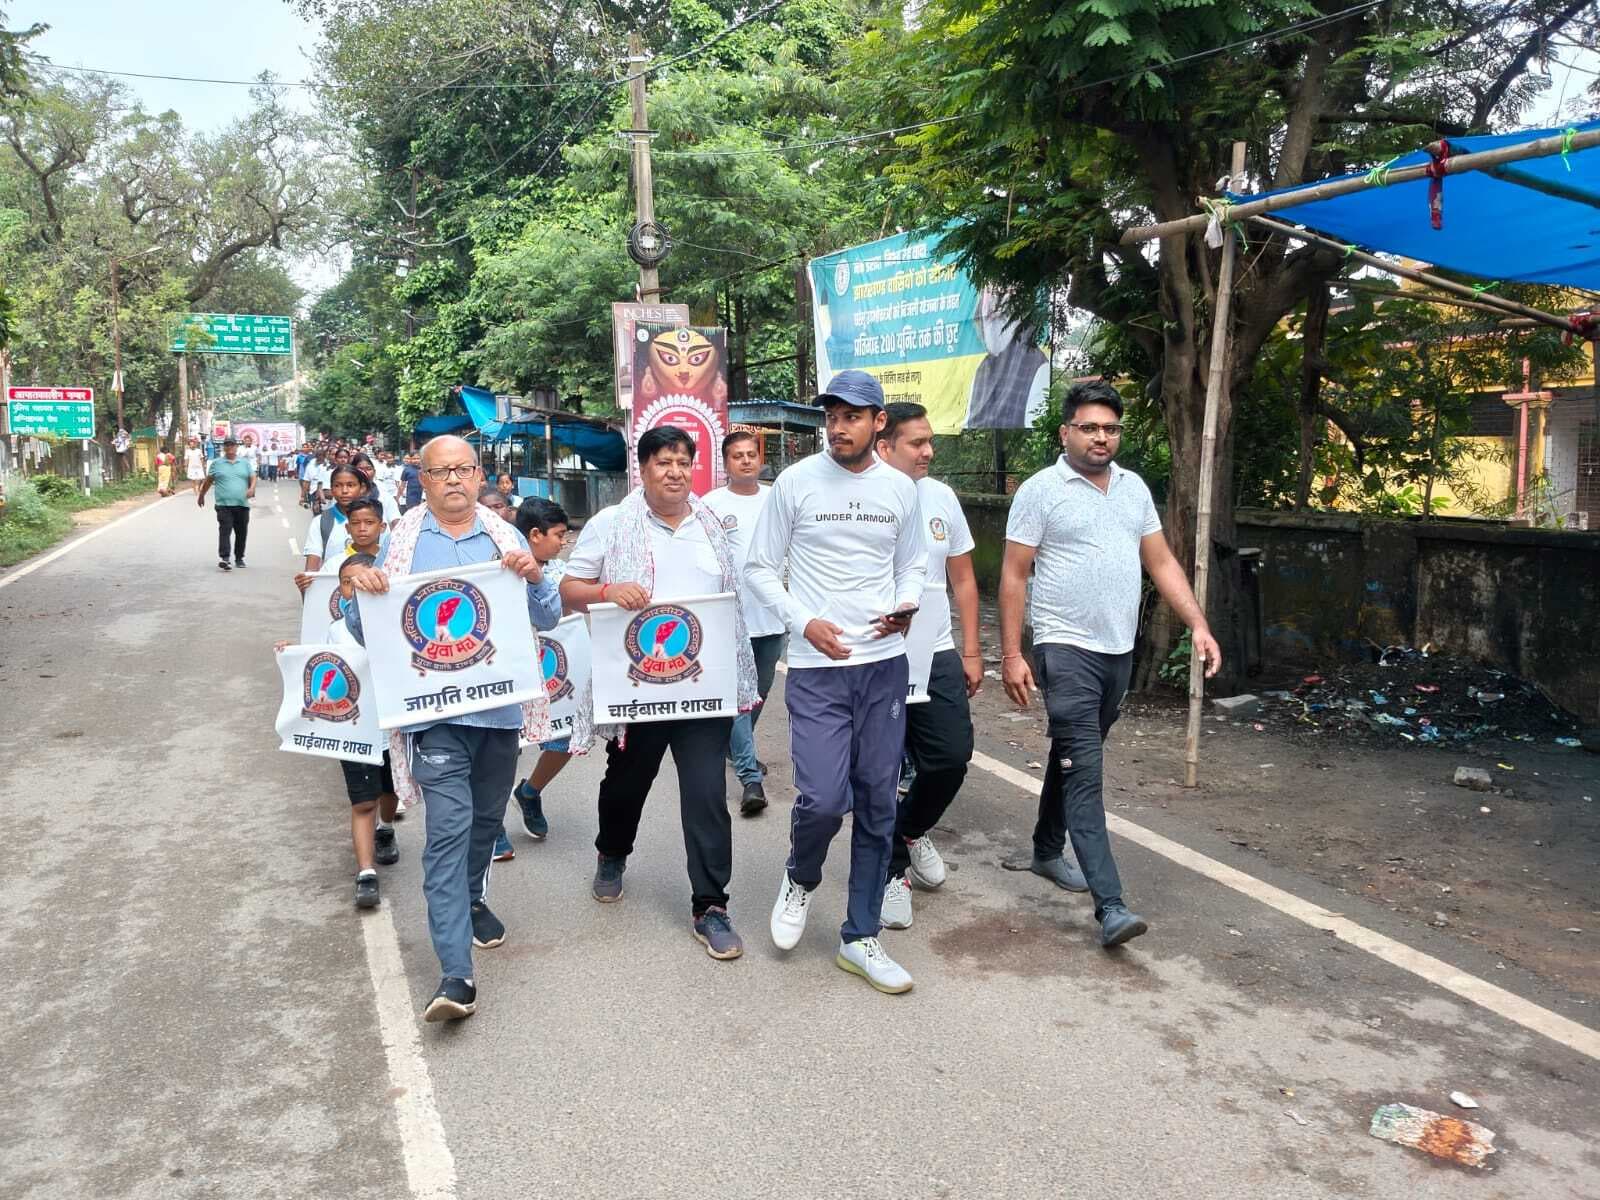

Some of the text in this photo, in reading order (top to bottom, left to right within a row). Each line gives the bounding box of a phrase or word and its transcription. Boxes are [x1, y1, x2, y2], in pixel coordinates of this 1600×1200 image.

[880, 334, 896, 353] 200
[918, 328, 932, 348] तक
[933, 319, 945, 345] की
[815, 513, 895, 524] UNDER ARMOUR
[426, 642, 454, 660] युवा
[643, 658, 665, 673] युवा
[404, 679, 514, 713] जागृति शाखा
[607, 698, 723, 720] चाईबासा शाखा
[293, 731, 373, 756] चाईबासा शाखा
